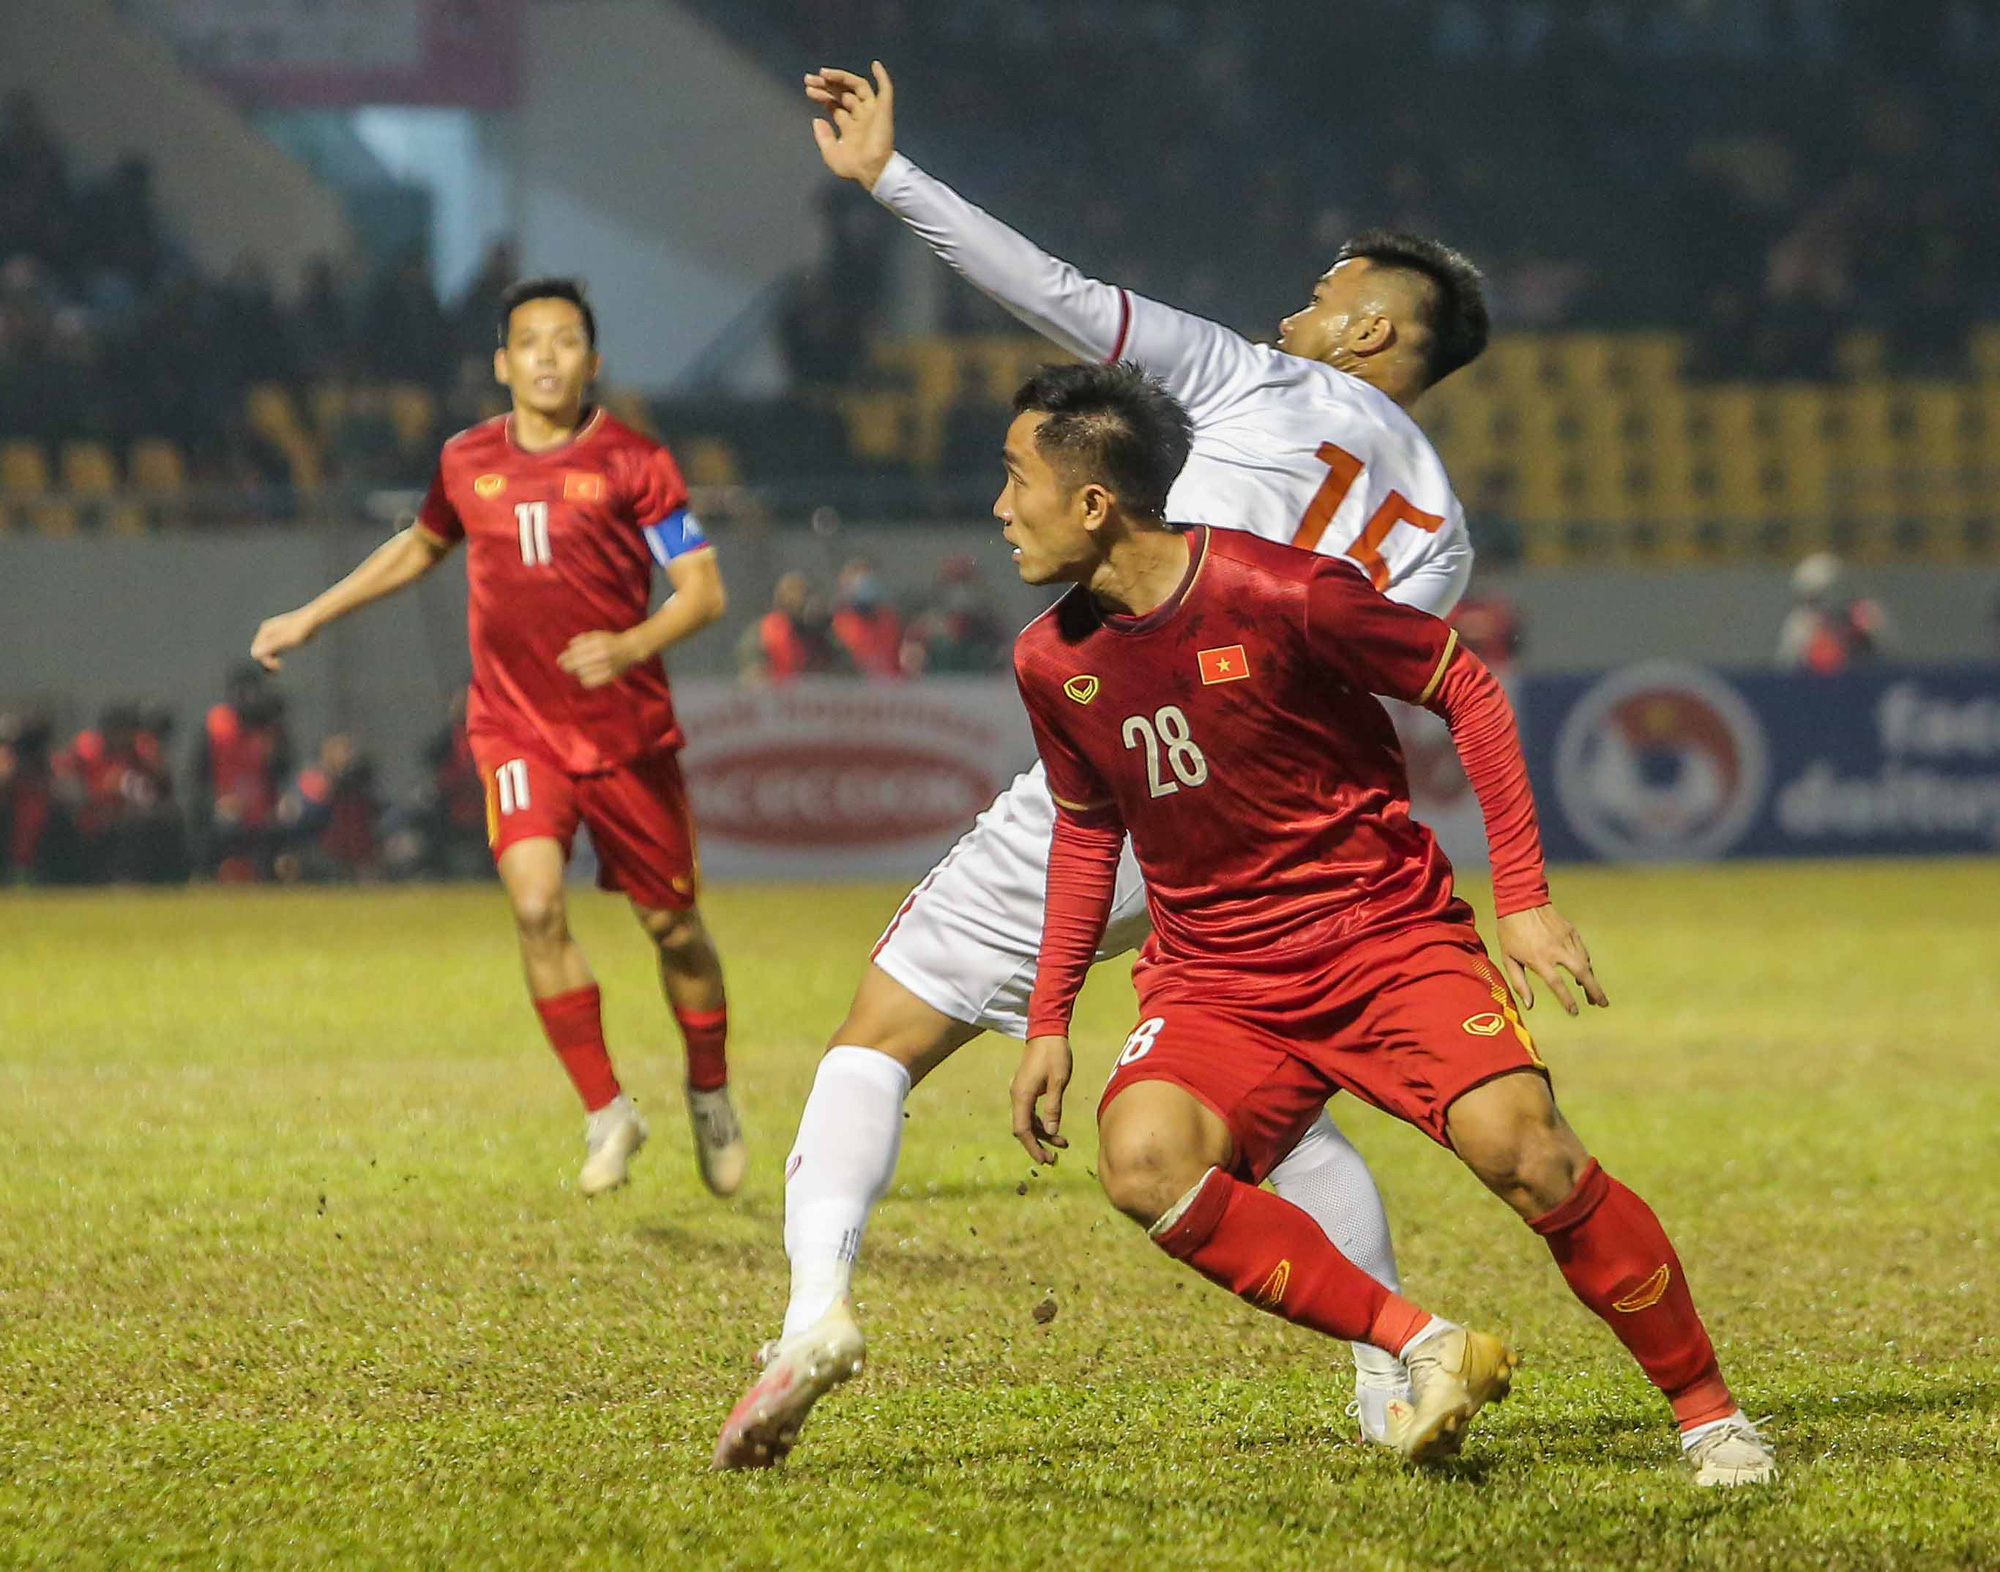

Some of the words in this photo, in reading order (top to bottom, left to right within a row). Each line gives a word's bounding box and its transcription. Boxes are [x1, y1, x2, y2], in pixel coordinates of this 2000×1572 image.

[514, 501, 552, 567] 11
[1122, 705, 1208, 799] 28
[495, 757, 532, 816] 11
